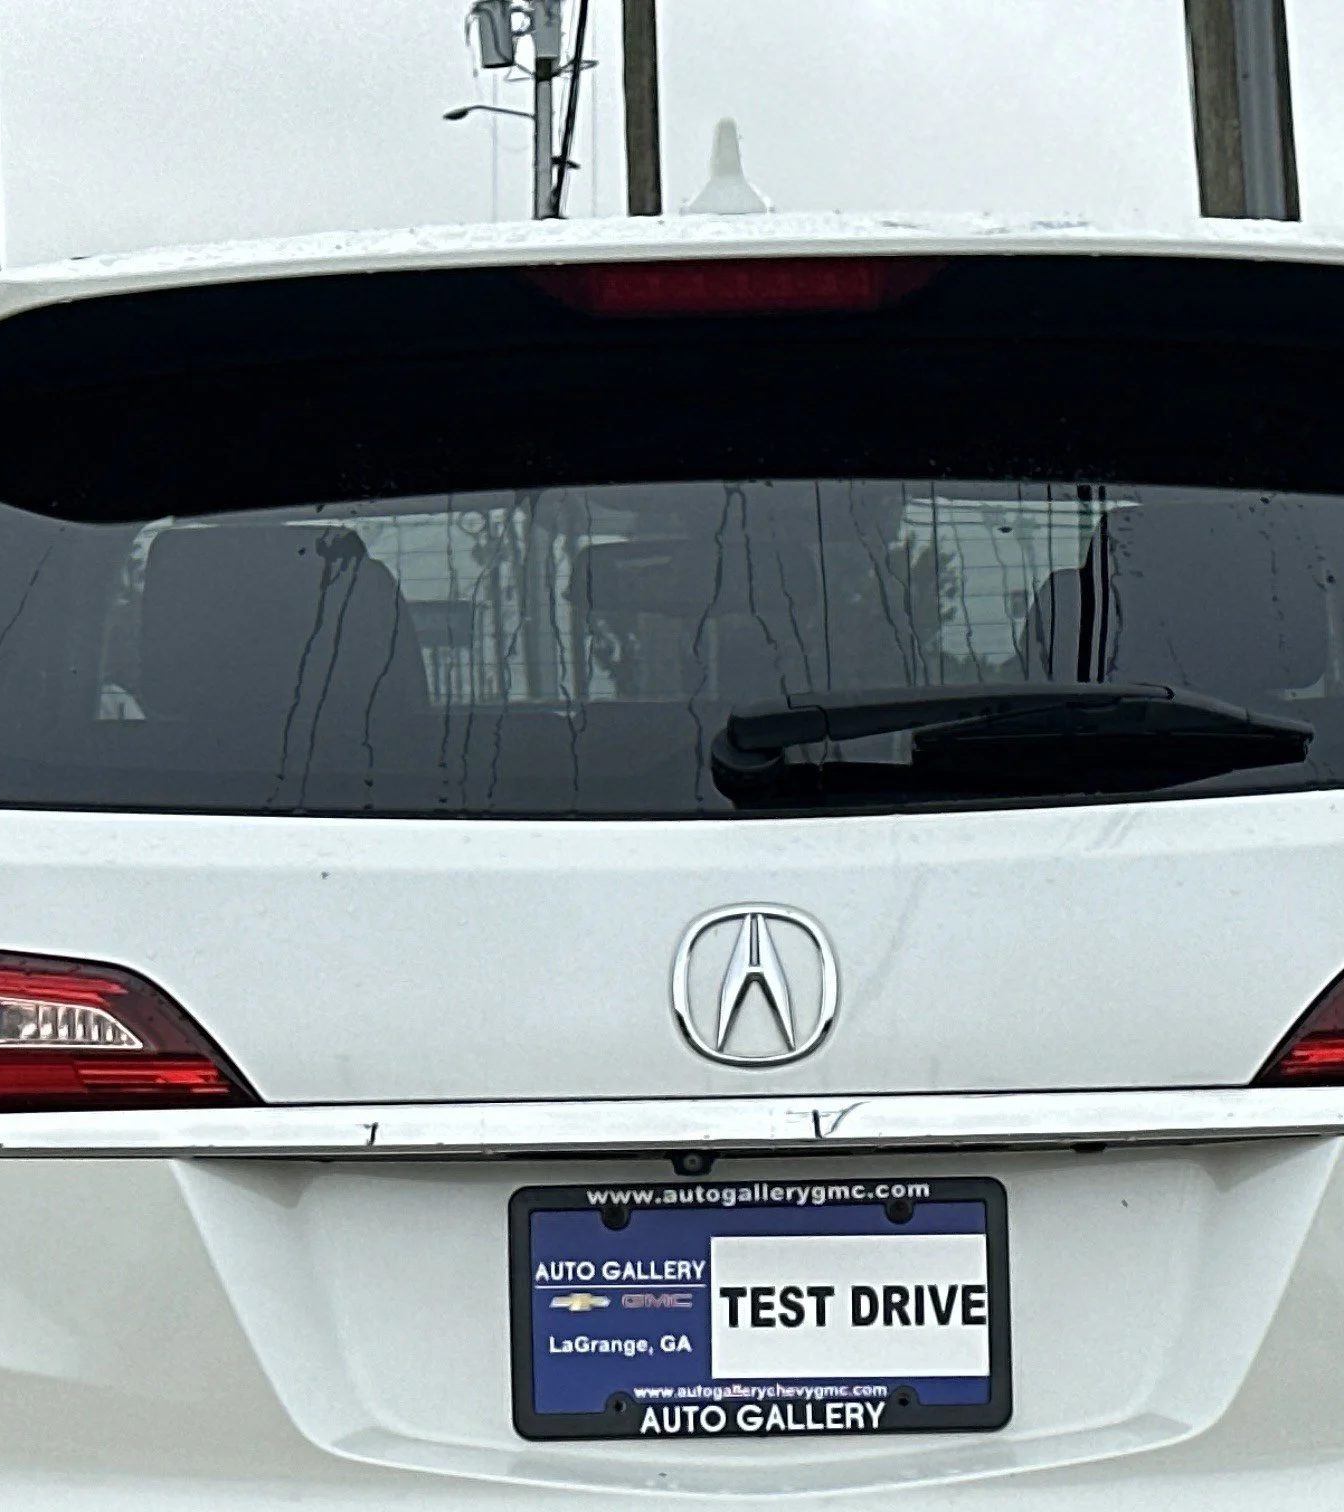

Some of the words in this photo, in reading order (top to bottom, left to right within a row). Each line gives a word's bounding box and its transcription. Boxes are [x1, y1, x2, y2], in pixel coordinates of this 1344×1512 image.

[586, 1182, 930, 1207] www.autogallerygmc.com
[535, 1262, 595, 1282] AUTO
[602, 1260, 706, 1281] GALLERY
[621, 1293, 693, 1309] GMC
[719, 1285, 835, 1327] TEST
[851, 1284, 987, 1327] DRIVE
[549, 1336, 655, 1357] LaGrange,
[660, 1334, 692, 1352] GA
[640, 1404, 726, 1434] AUTO
[736, 1401, 886, 1432] GALLERY
